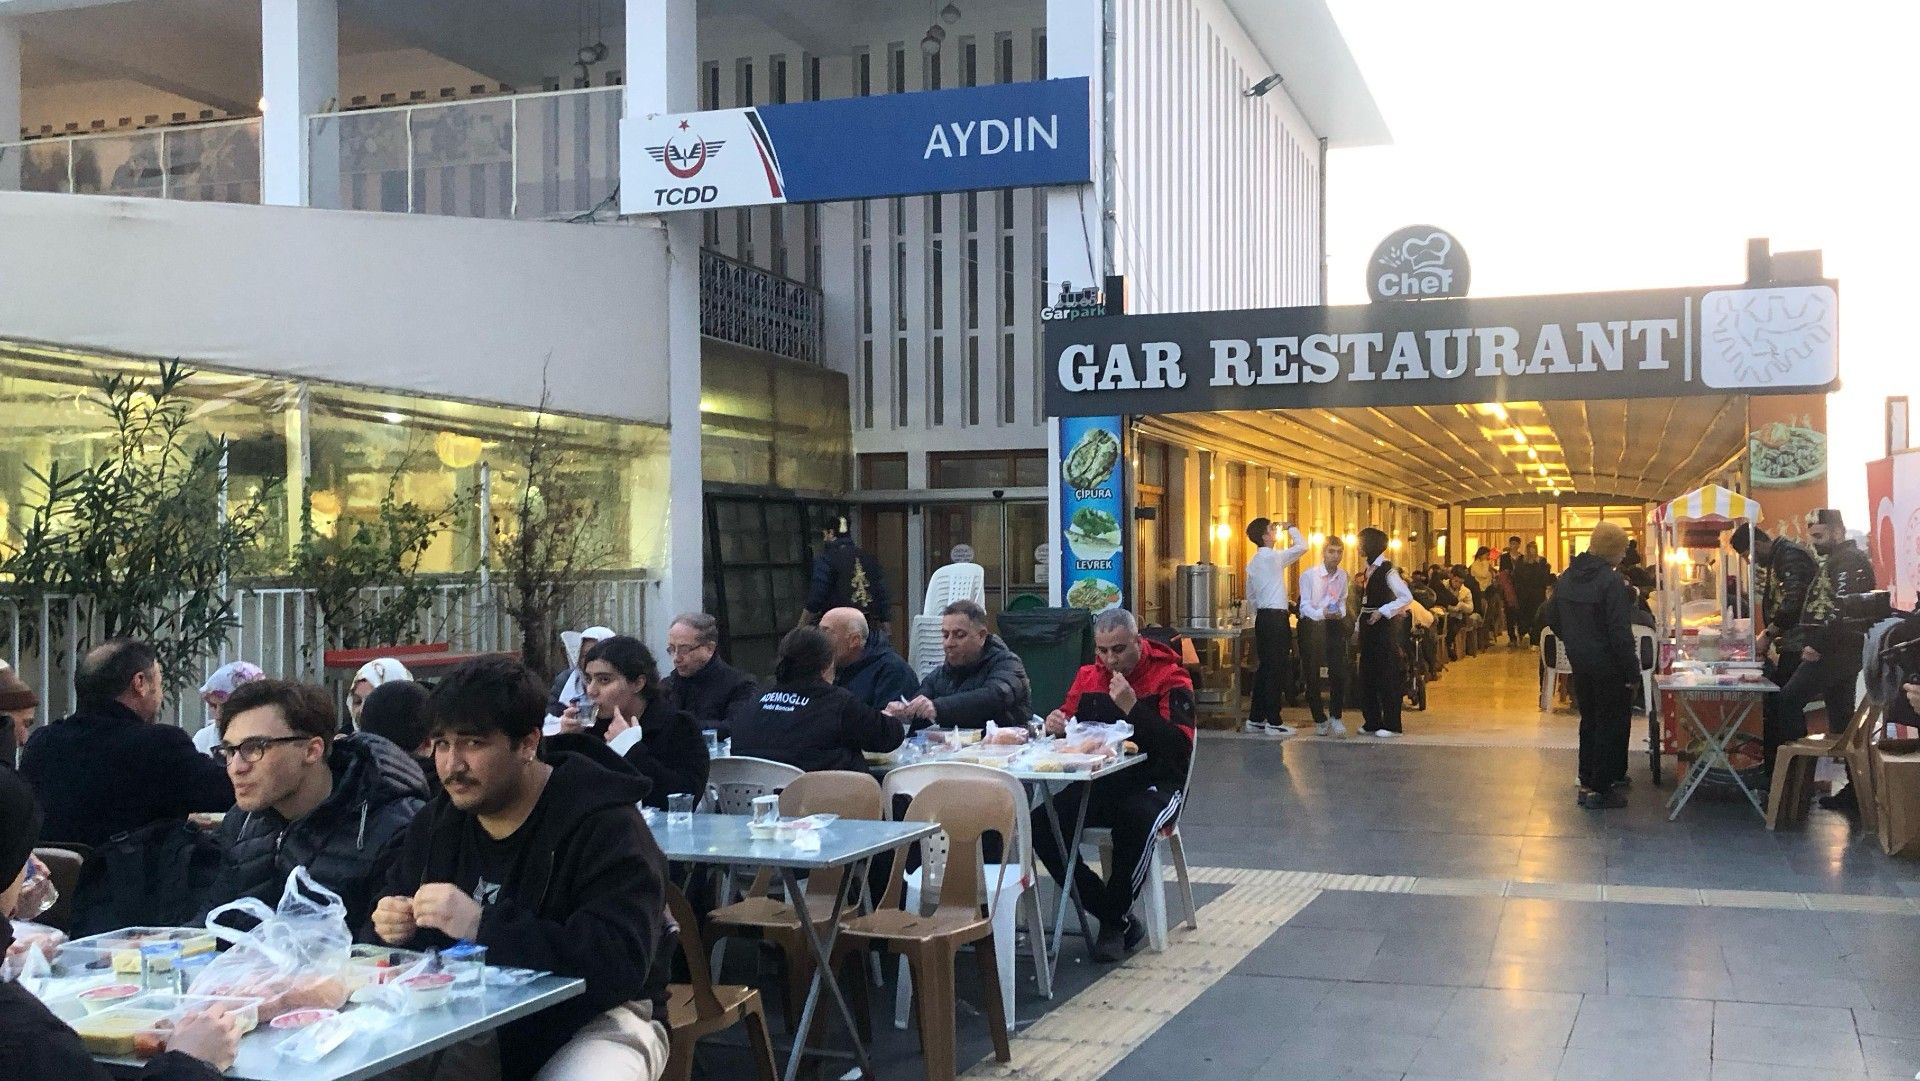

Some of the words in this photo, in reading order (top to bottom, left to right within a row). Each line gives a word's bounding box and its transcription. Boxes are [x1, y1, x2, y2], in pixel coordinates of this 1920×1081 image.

[923, 114, 1058, 160] AYDIN
[654, 185, 719, 206] TCDD
[1377, 267, 1454, 297] Chef
[1040, 307, 1106, 322] Garpark
[1057, 341, 1187, 393] GAR
[1209, 318, 1678, 387] RESTAURANT
[1075, 487, 1112, 501] ÇİPURA
[1076, 560, 1112, 570] LEVREK
